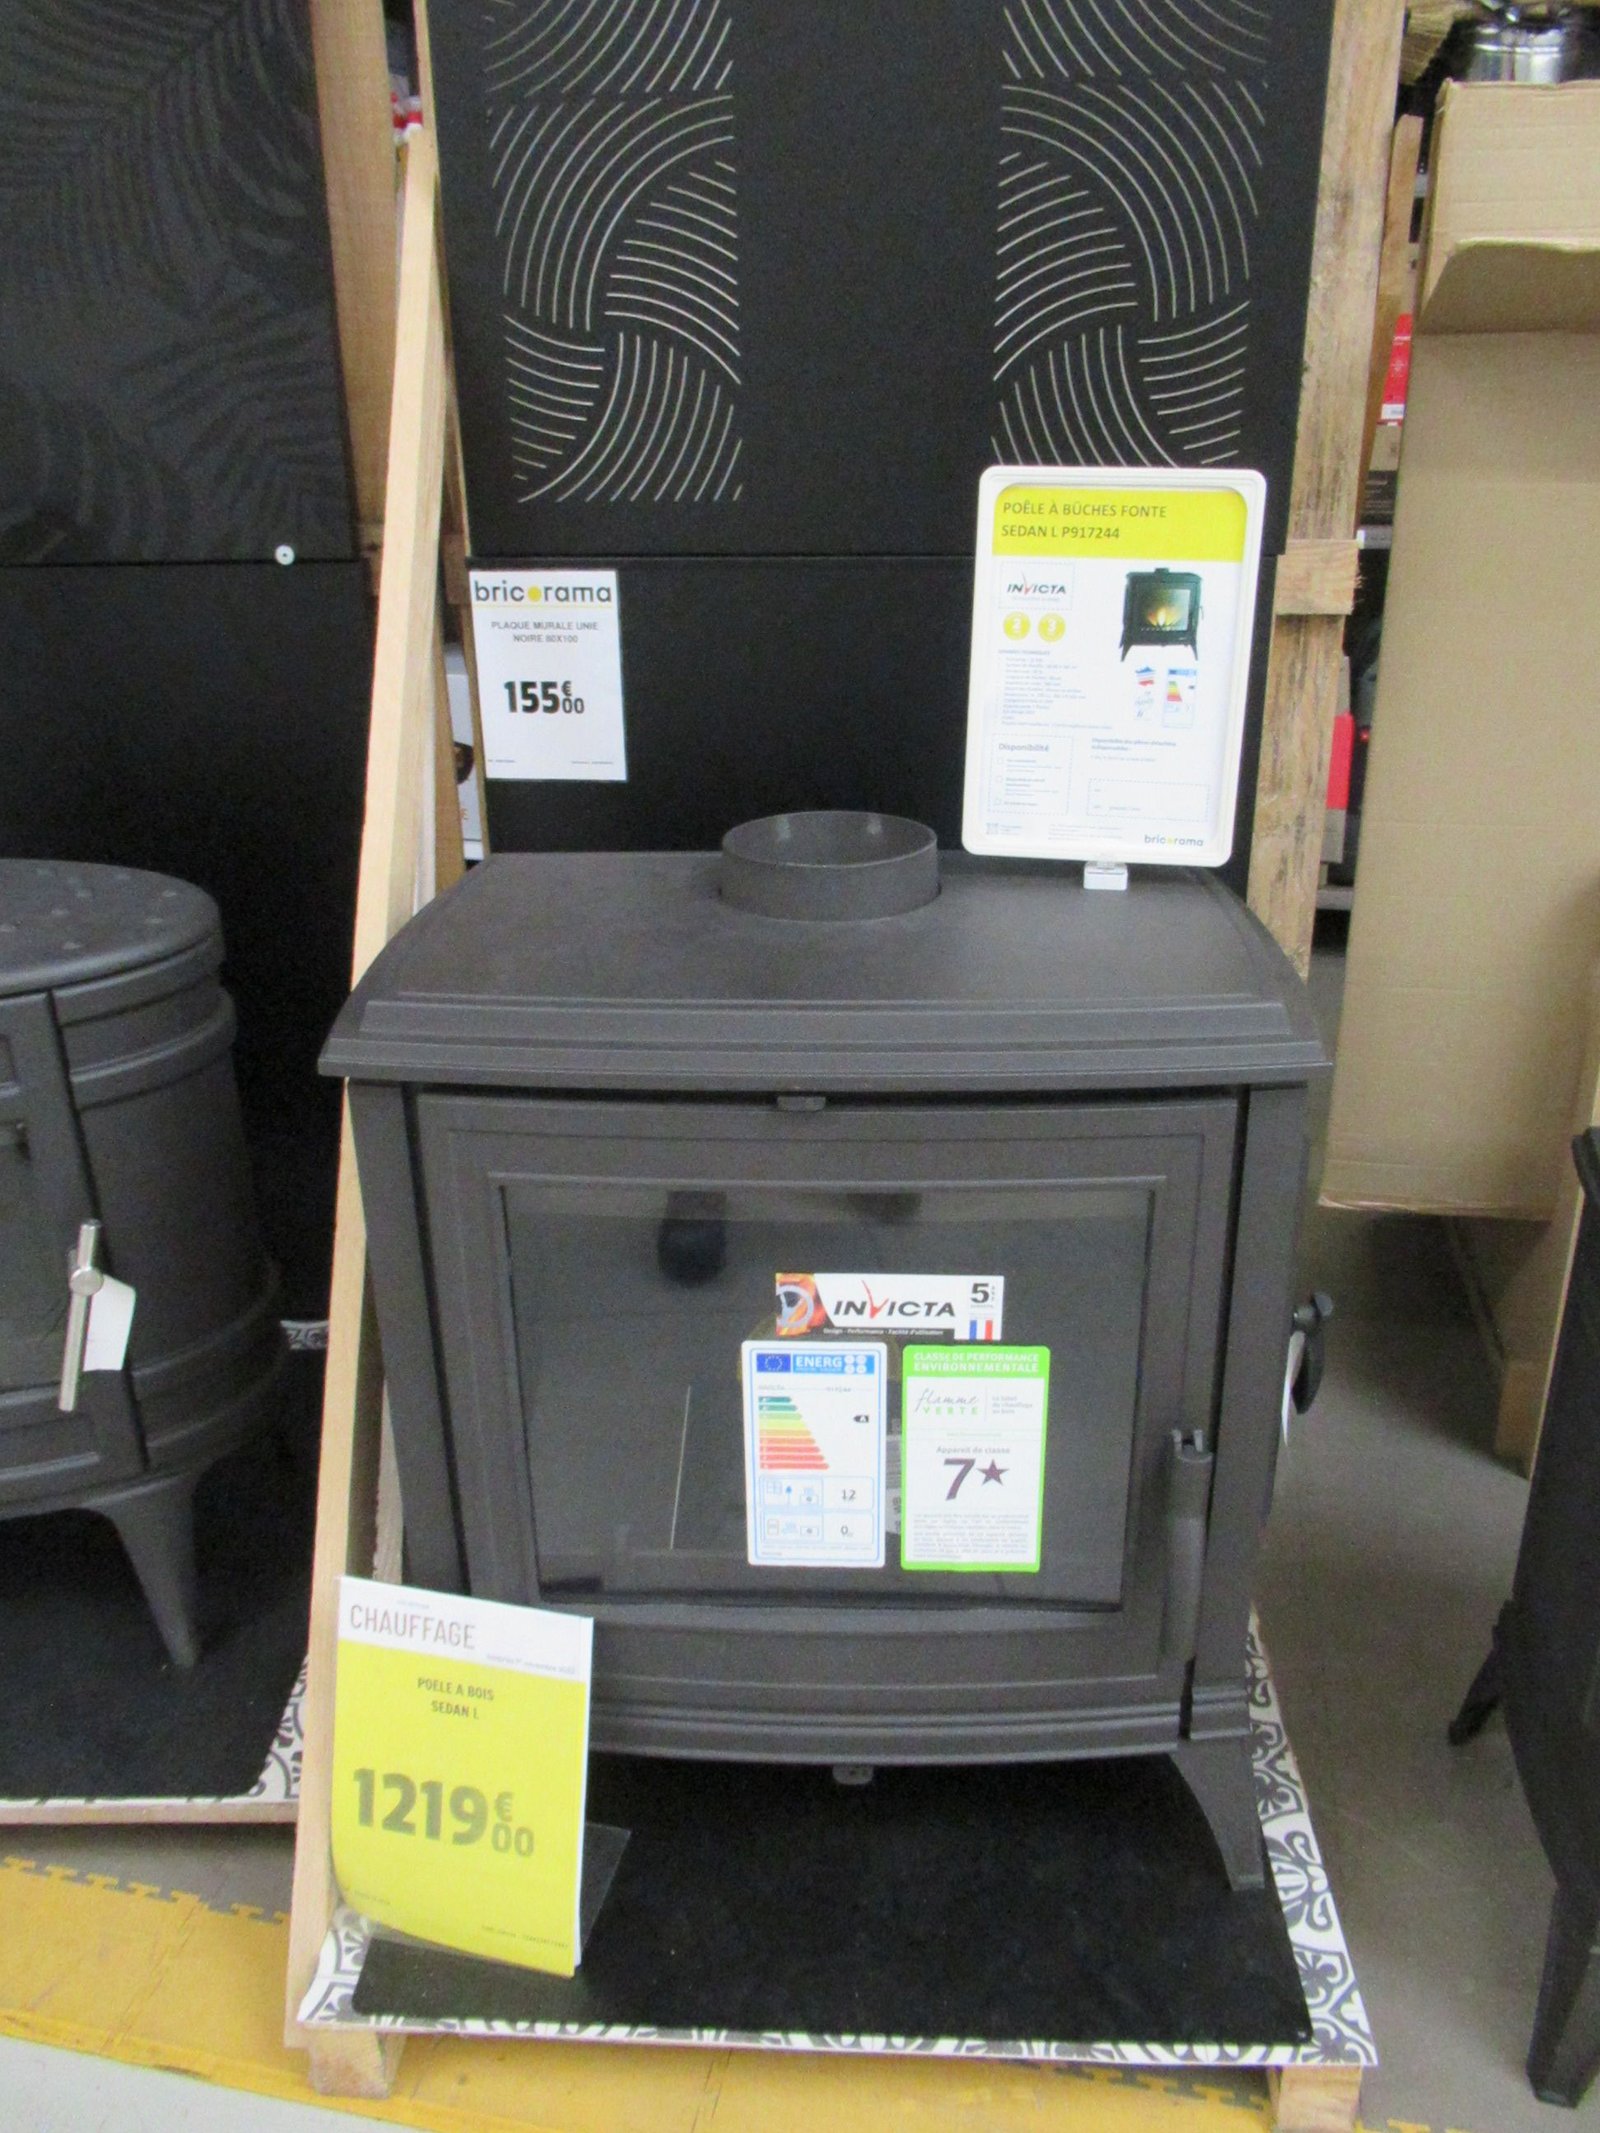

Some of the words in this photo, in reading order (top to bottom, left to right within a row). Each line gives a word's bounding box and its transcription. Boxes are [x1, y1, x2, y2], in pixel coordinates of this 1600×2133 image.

[1003, 500, 1044, 515] POÊLE
[1049, 500, 1058, 515] À
[1063, 501, 1116, 517] BÛCHES
[1121, 505, 1167, 518] FONTE
[1002, 525, 1047, 537] SEDAN
[1051, 527, 1056, 537] L
[1062, 527, 1120, 539] P917244
[475, 580, 612, 603] bricorama
[1007, 575, 1067, 594] INVICTA
[491, 621, 530, 631] PLAQUE
[533, 621, 573, 631] MURALE
[576, 622, 598, 631] UNIE
[513, 633, 544, 643] NOIRE
[1144, 834, 1204, 847] bricorama
[970, 1283, 990, 1303] 5
[834, 1288, 955, 1319] INVICTA
[796, 1356, 842, 1368] ENERG
[913, 1352, 949, 1361] CLASSE
[952, 1352, 964, 1361] DE
[966, 1353, 1039, 1362] PERFORMANCE
[913, 1362, 1039, 1373] ENVIRONNEMENTALE
[923, 1407, 978, 1415] VERTE
[944, 1458, 976, 1501] 7
[349, 1604, 476, 1650] CHAUFFAGE
[417, 1677, 452, 1694] POELE
[455, 1684, 464, 1696] A
[467, 1685, 495, 1702] BOIS
[431, 1700, 470, 1717] SEDAN
